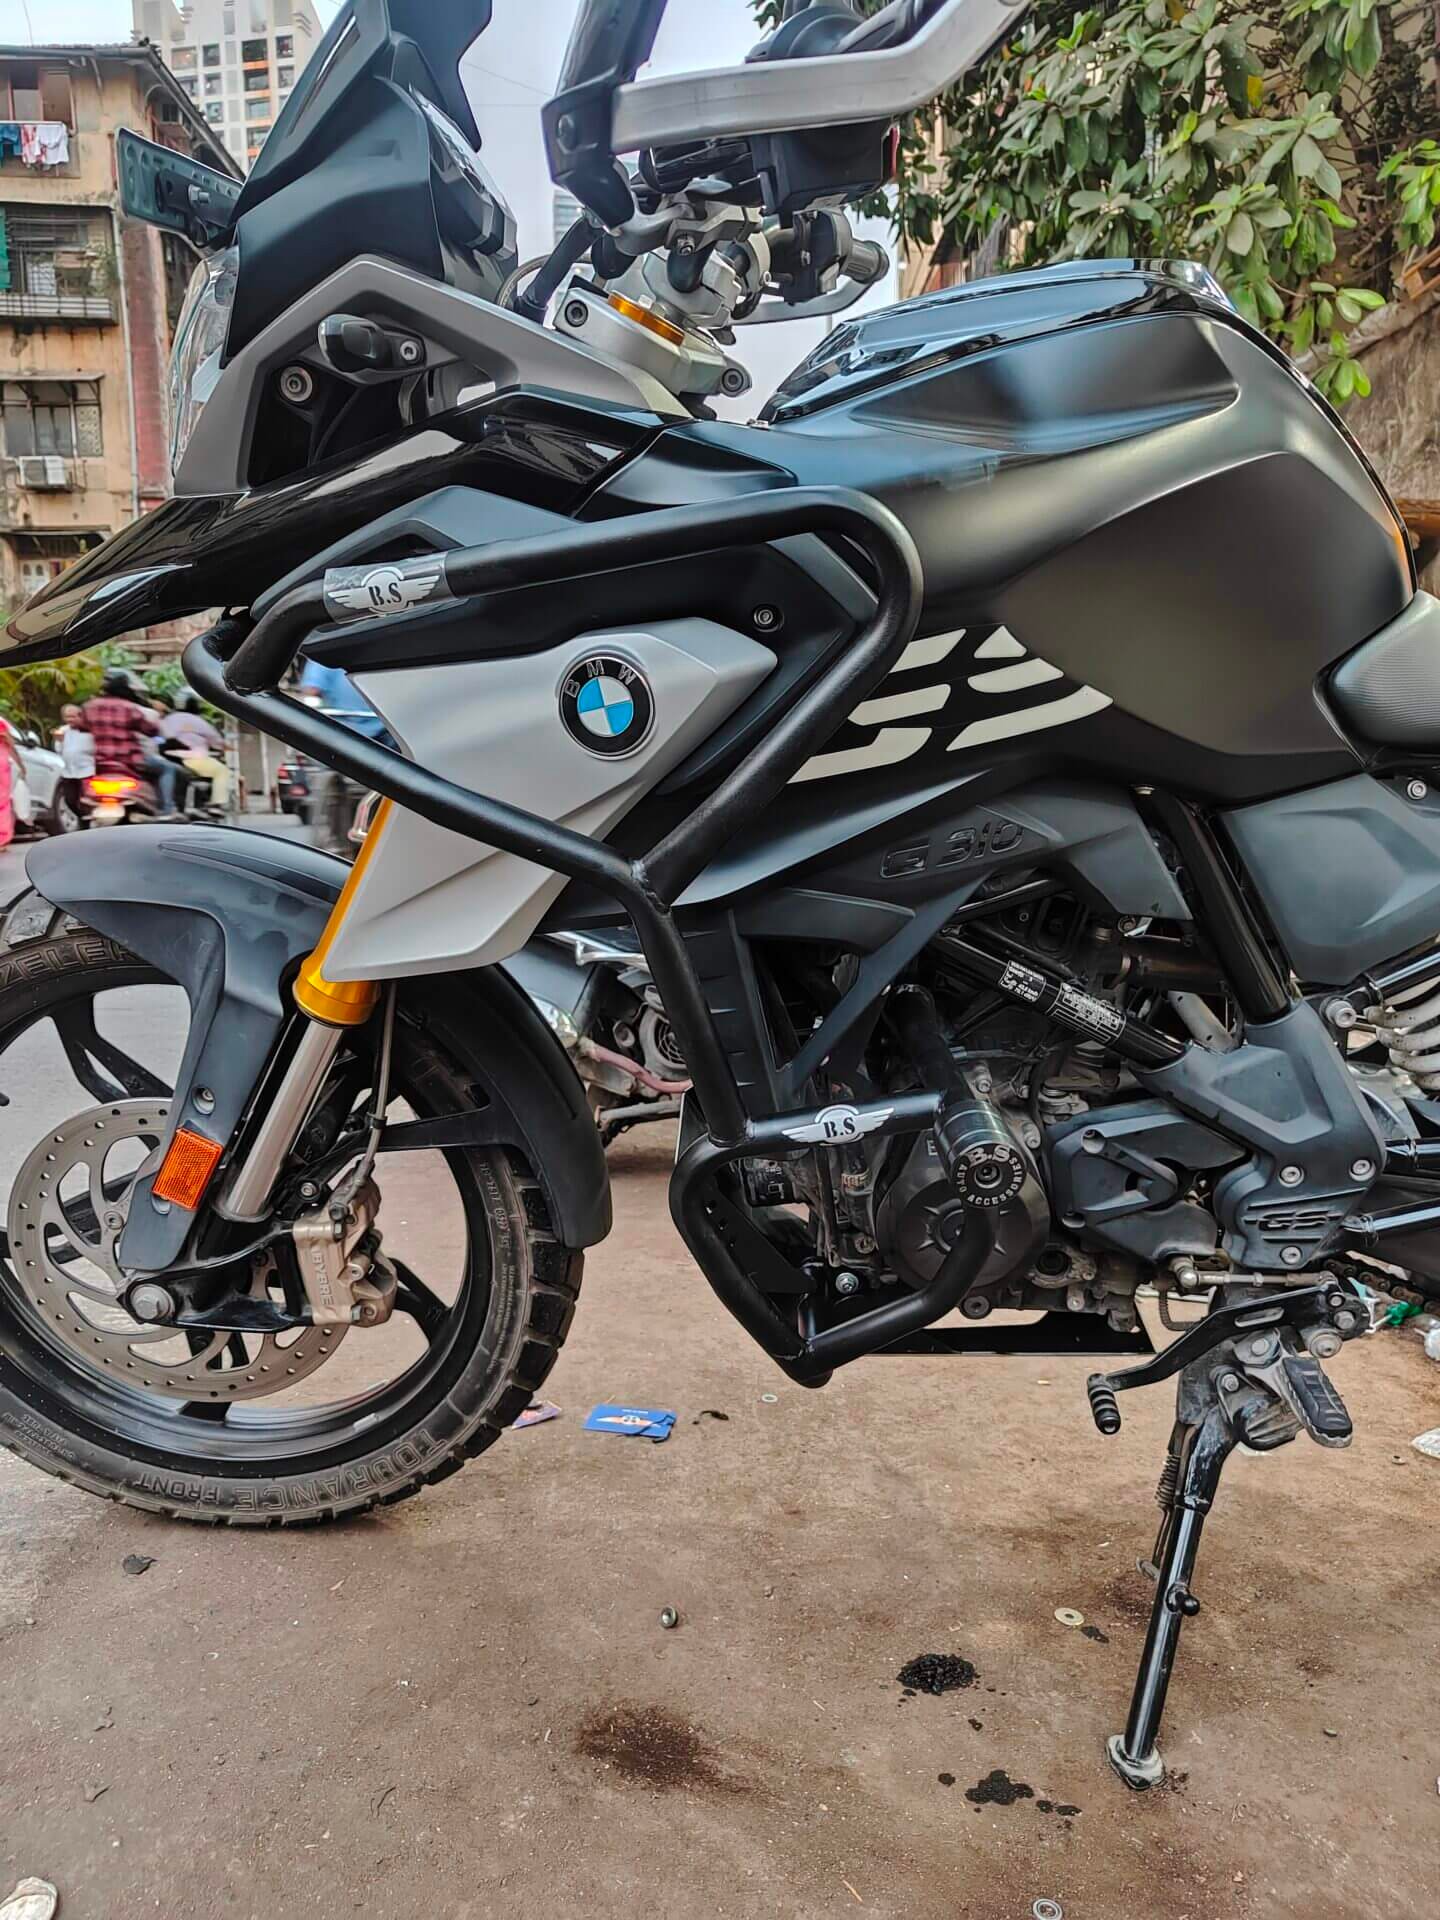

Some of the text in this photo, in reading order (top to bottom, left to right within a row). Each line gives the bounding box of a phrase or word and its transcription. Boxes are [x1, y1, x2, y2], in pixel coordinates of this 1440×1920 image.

[367, 582, 403, 606] B.S
[564, 659, 637, 698] BMW
[936, 821, 1024, 868] 310
[823, 1117, 856, 1138] B.S
[956, 1156, 1023, 1206] AUTO ACCESSORIES
[133, 1428, 449, 1512] TOURANCE FRONT
